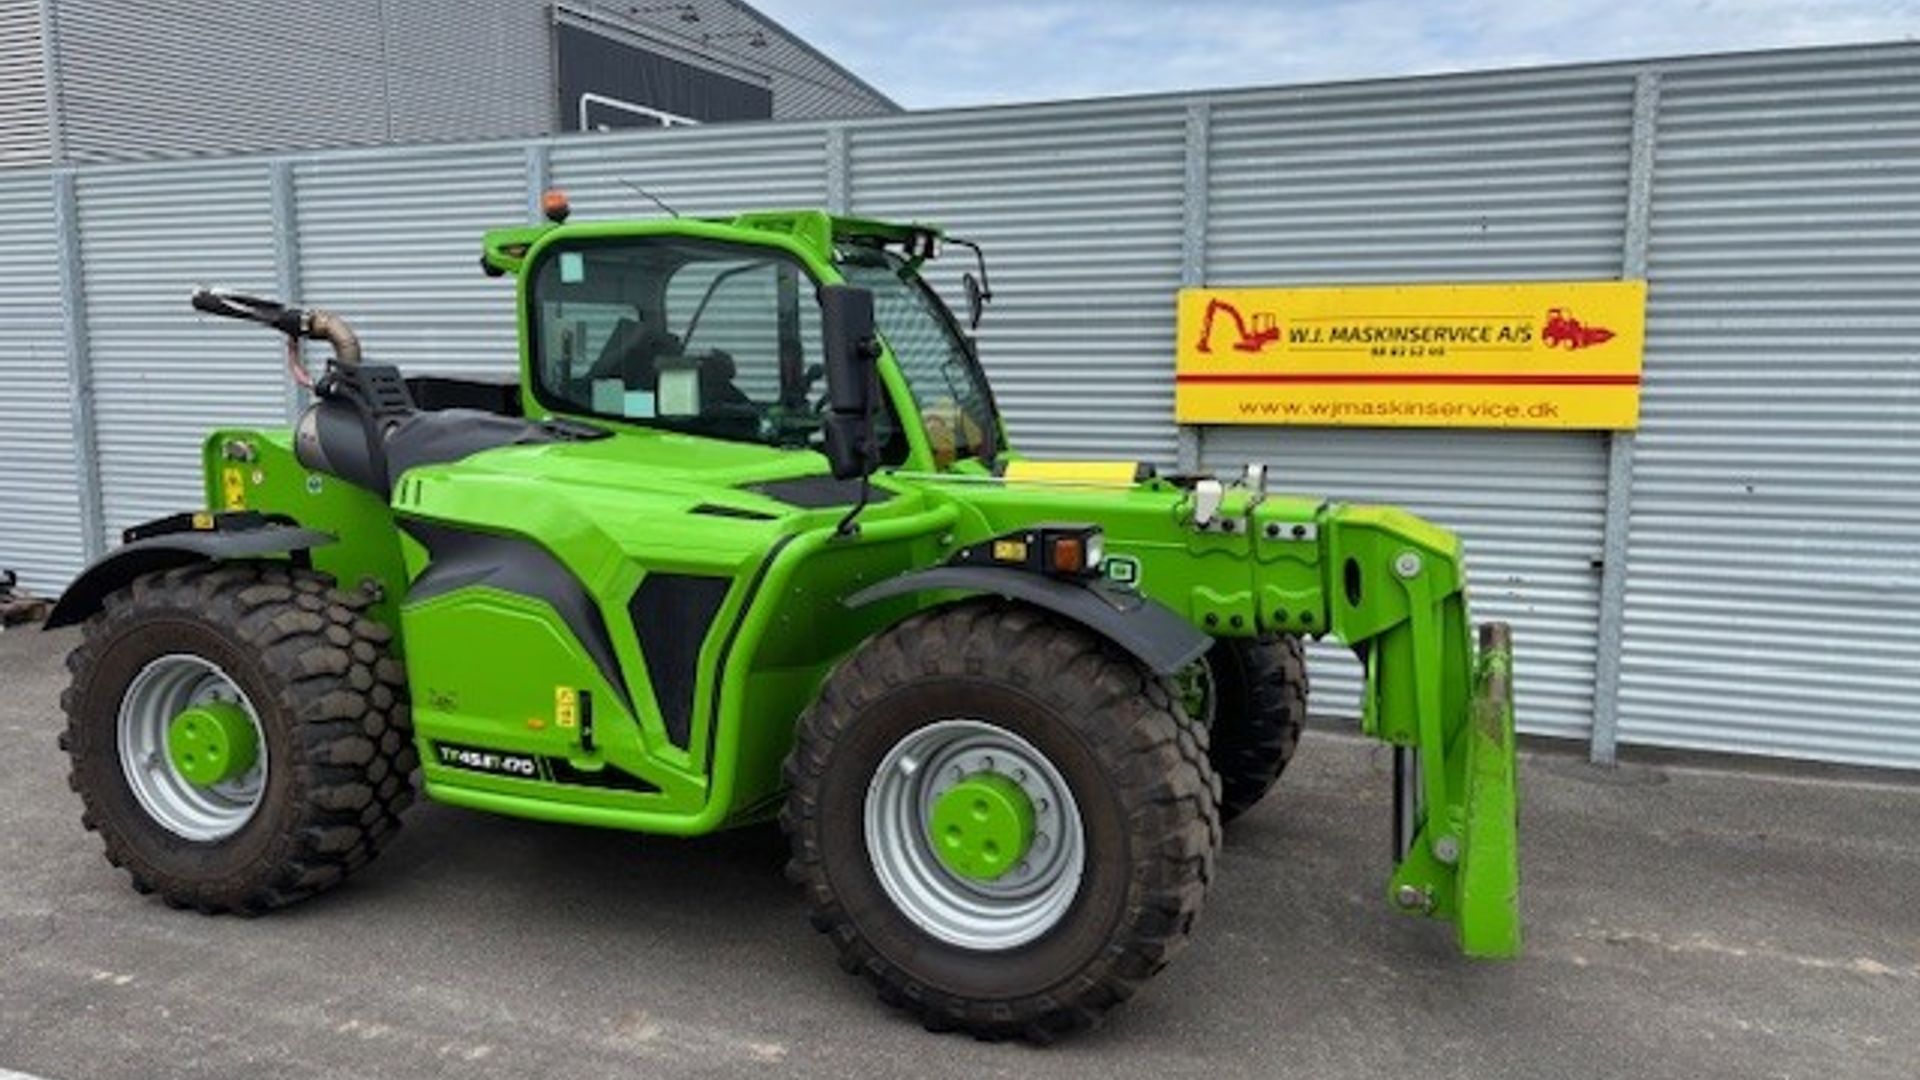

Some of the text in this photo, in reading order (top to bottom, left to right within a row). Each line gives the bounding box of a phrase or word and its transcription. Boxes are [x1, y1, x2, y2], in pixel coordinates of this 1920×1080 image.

[1329, 325, 1491, 343] MASKINSERVICE
[1497, 324, 1532, 342] A/S
[1239, 400, 1559, 419] www.wjmaskinservice.dk
